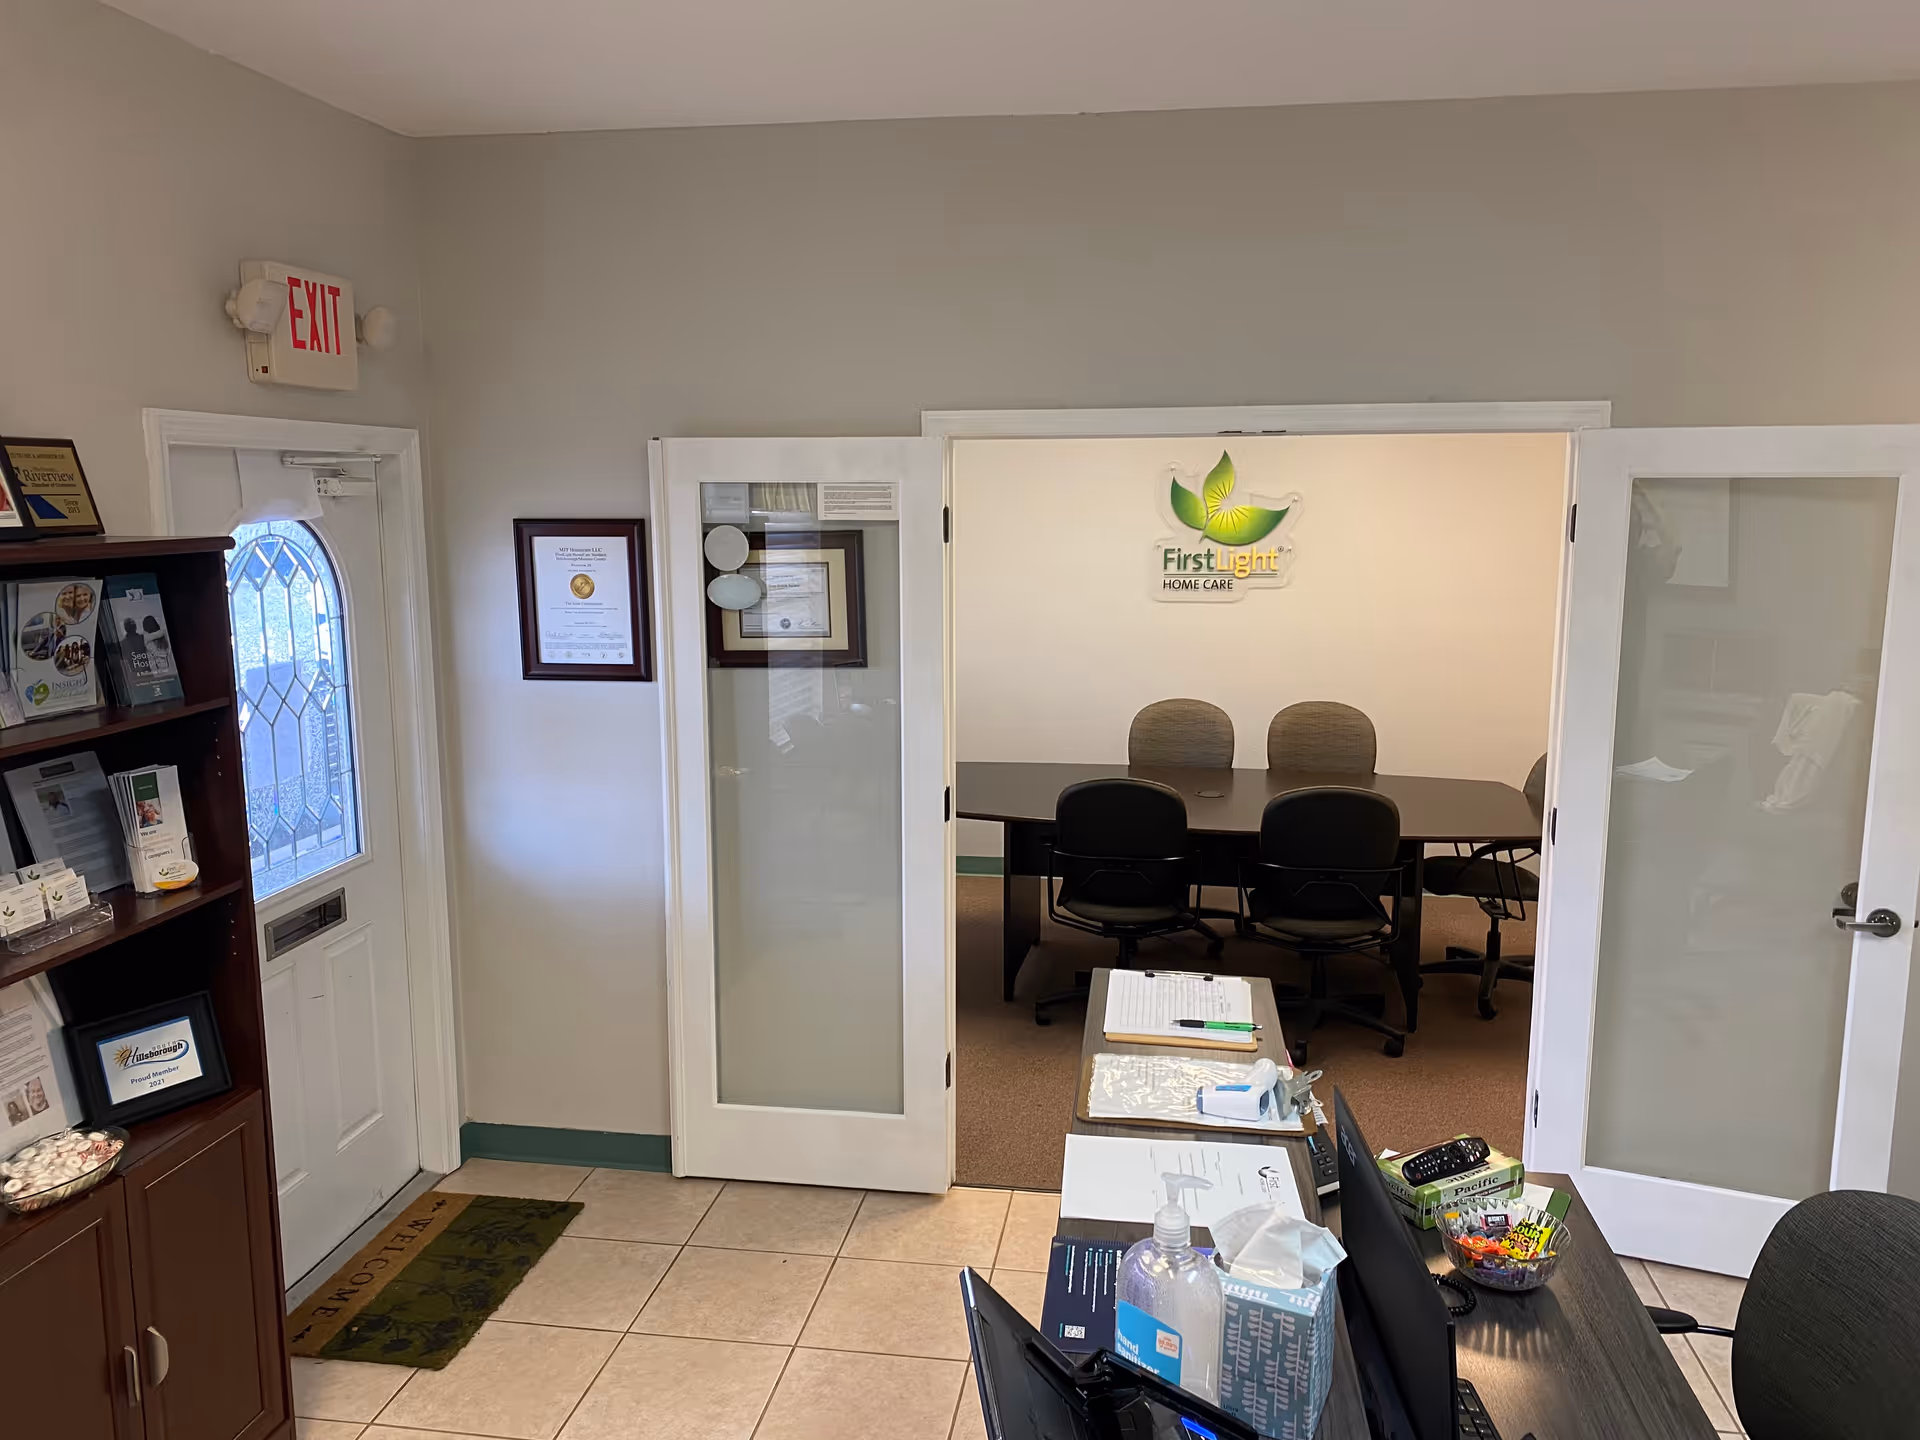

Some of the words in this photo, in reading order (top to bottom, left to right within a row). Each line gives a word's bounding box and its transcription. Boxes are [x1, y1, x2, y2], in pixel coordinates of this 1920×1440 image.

[287, 276, 341, 356] EXIT
[22, 469, 74, 482] Riverview
[1163, 546, 1279, 579] FirstLight
[1163, 579, 1200, 590] HOME
[1203, 579, 1234, 590] CARE
[120, 1042, 183, 1067] Hillsborough
[130, 1073, 151, 1084] Proud
[152, 1066, 179, 1078] Member
[149, 1078, 165, 1088] 2021
[1454, 1176, 1499, 1197] Pacific
[1506, 1231, 1539, 1251] PATCH
[1513, 1225, 1541, 1240] SOUR
[311, 1216, 435, 1319] WELCOME
[1117, 1328, 1139, 1355] hand
